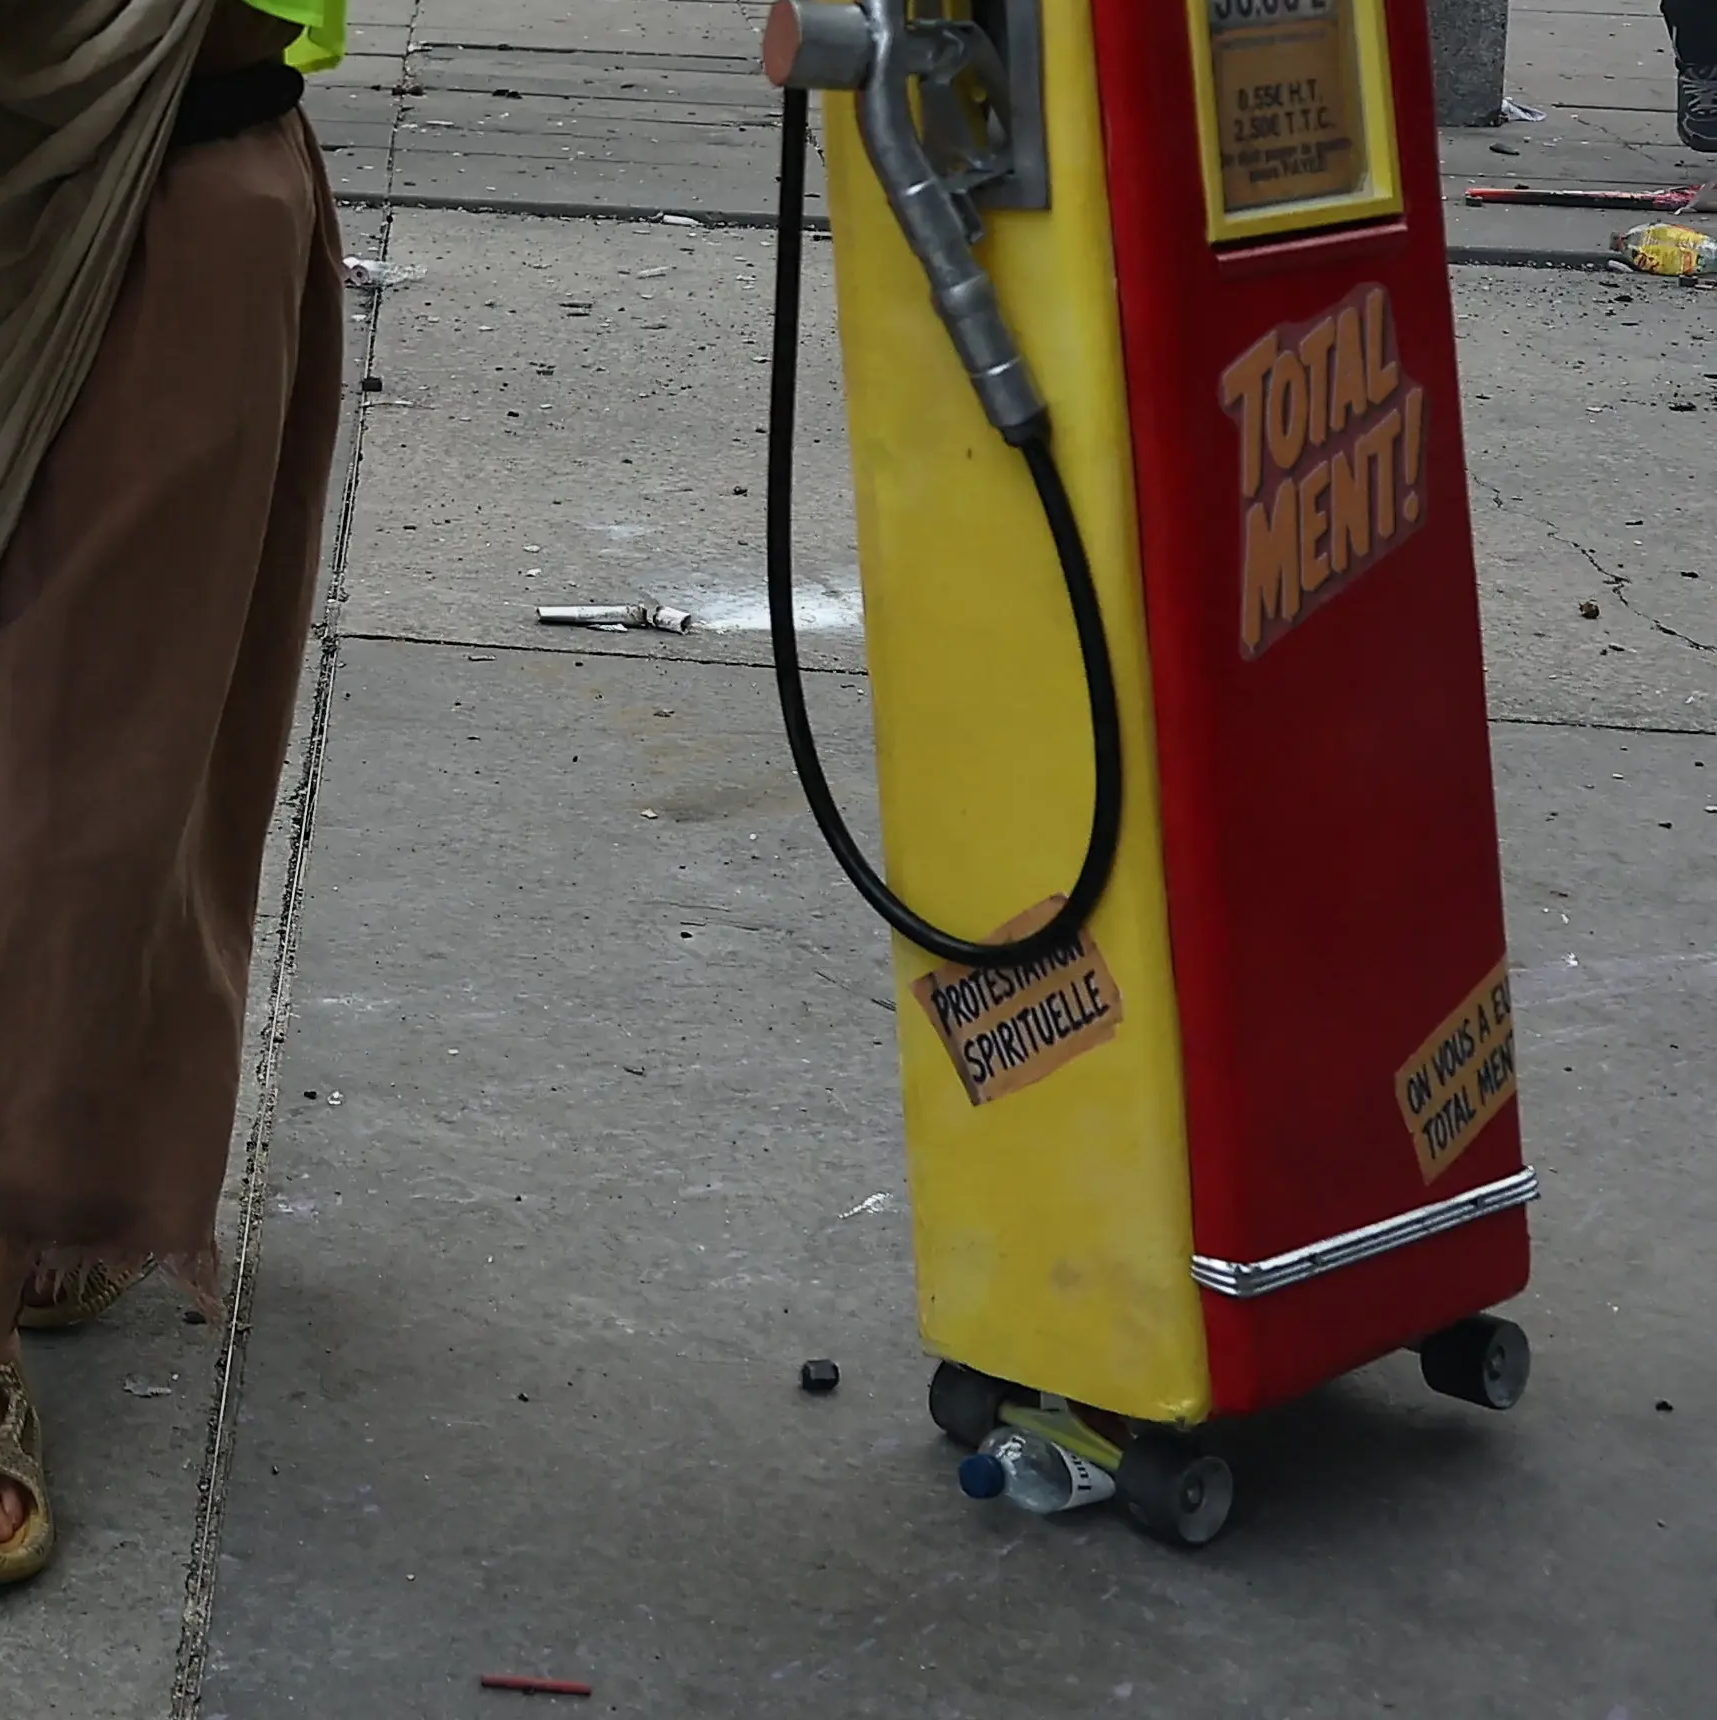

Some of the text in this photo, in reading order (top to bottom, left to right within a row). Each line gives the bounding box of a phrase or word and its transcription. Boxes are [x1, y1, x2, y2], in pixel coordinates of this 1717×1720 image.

[1222, 287, 1399, 498] TOTAL
[1241, 386, 1424, 650] MENT!
[963, 969, 1110, 1085] SPIRITUELLE
[1406, 1064, 1432, 1115] ON
[1432, 1018, 1475, 1086] VOUS
[1477, 1003, 1490, 1043] A
[1422, 1029, 1514, 1160] TOTAL MEN
